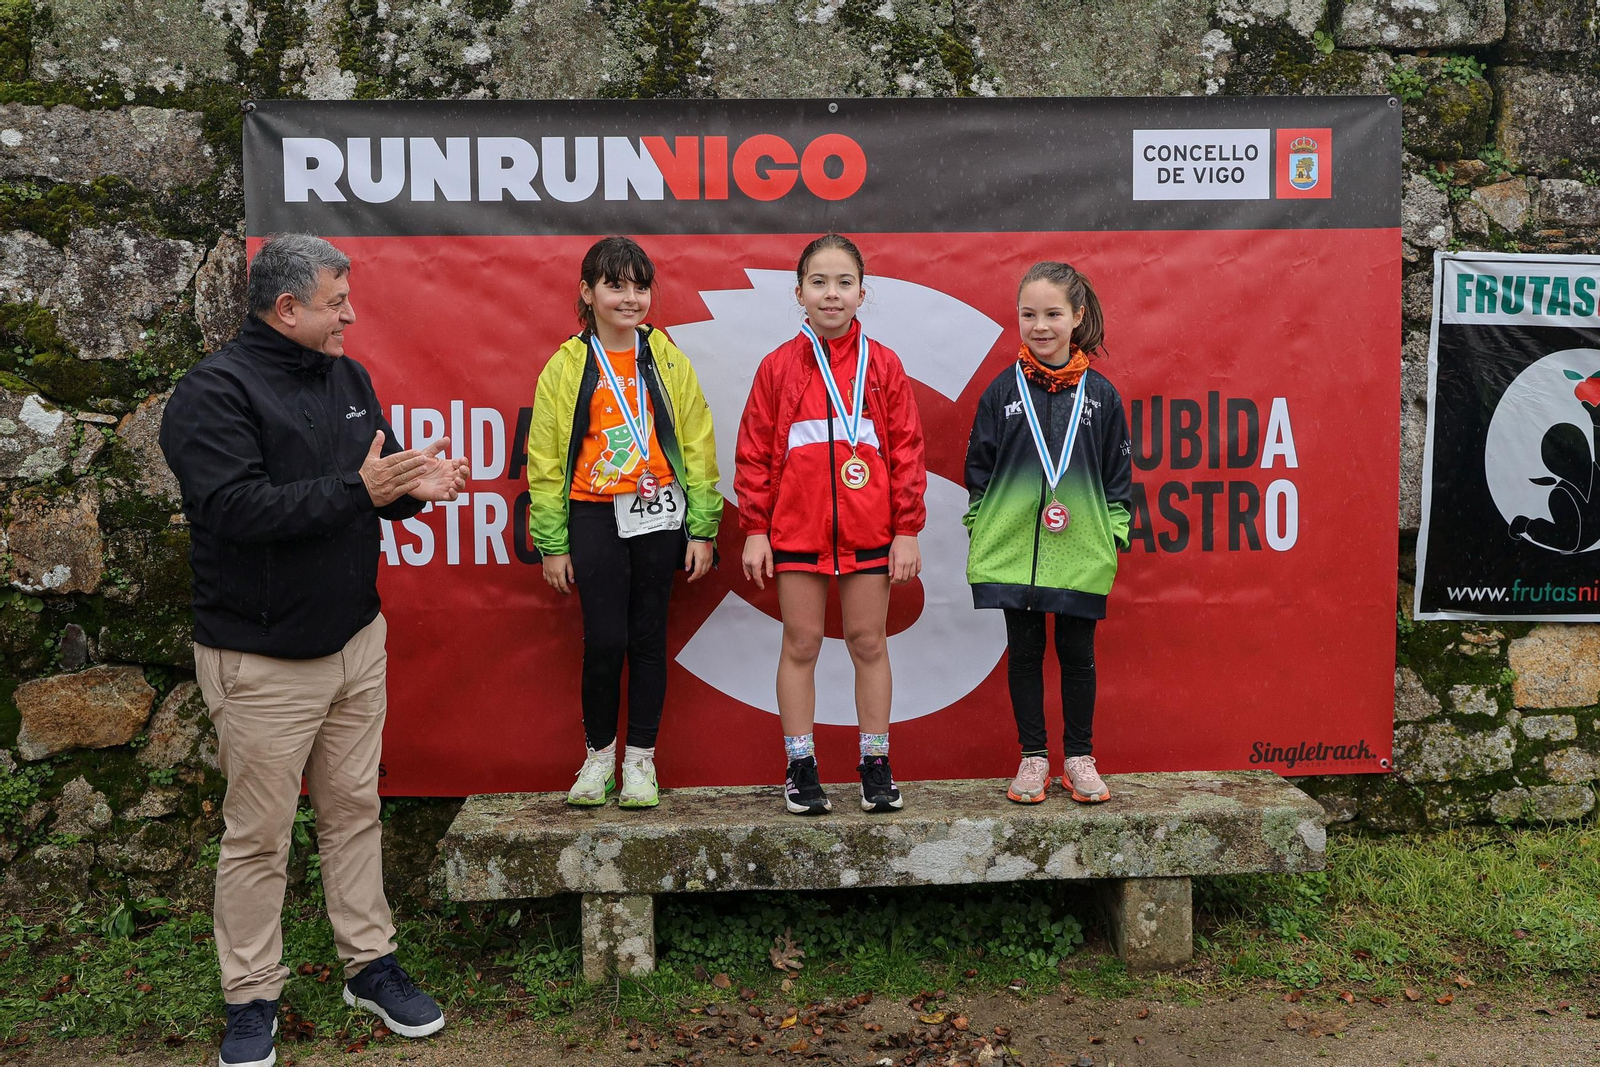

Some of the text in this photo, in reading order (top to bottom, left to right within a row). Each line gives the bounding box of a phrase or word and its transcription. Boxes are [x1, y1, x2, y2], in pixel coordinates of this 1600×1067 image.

[282, 132, 867, 203] RUNRUNVIGO
[1143, 144, 1259, 162] CONCELLO
[1157, 166, 1245, 184] DE VIGO
[1456, 273, 1600, 317] FRUTAS
[629, 489, 677, 519] 483
